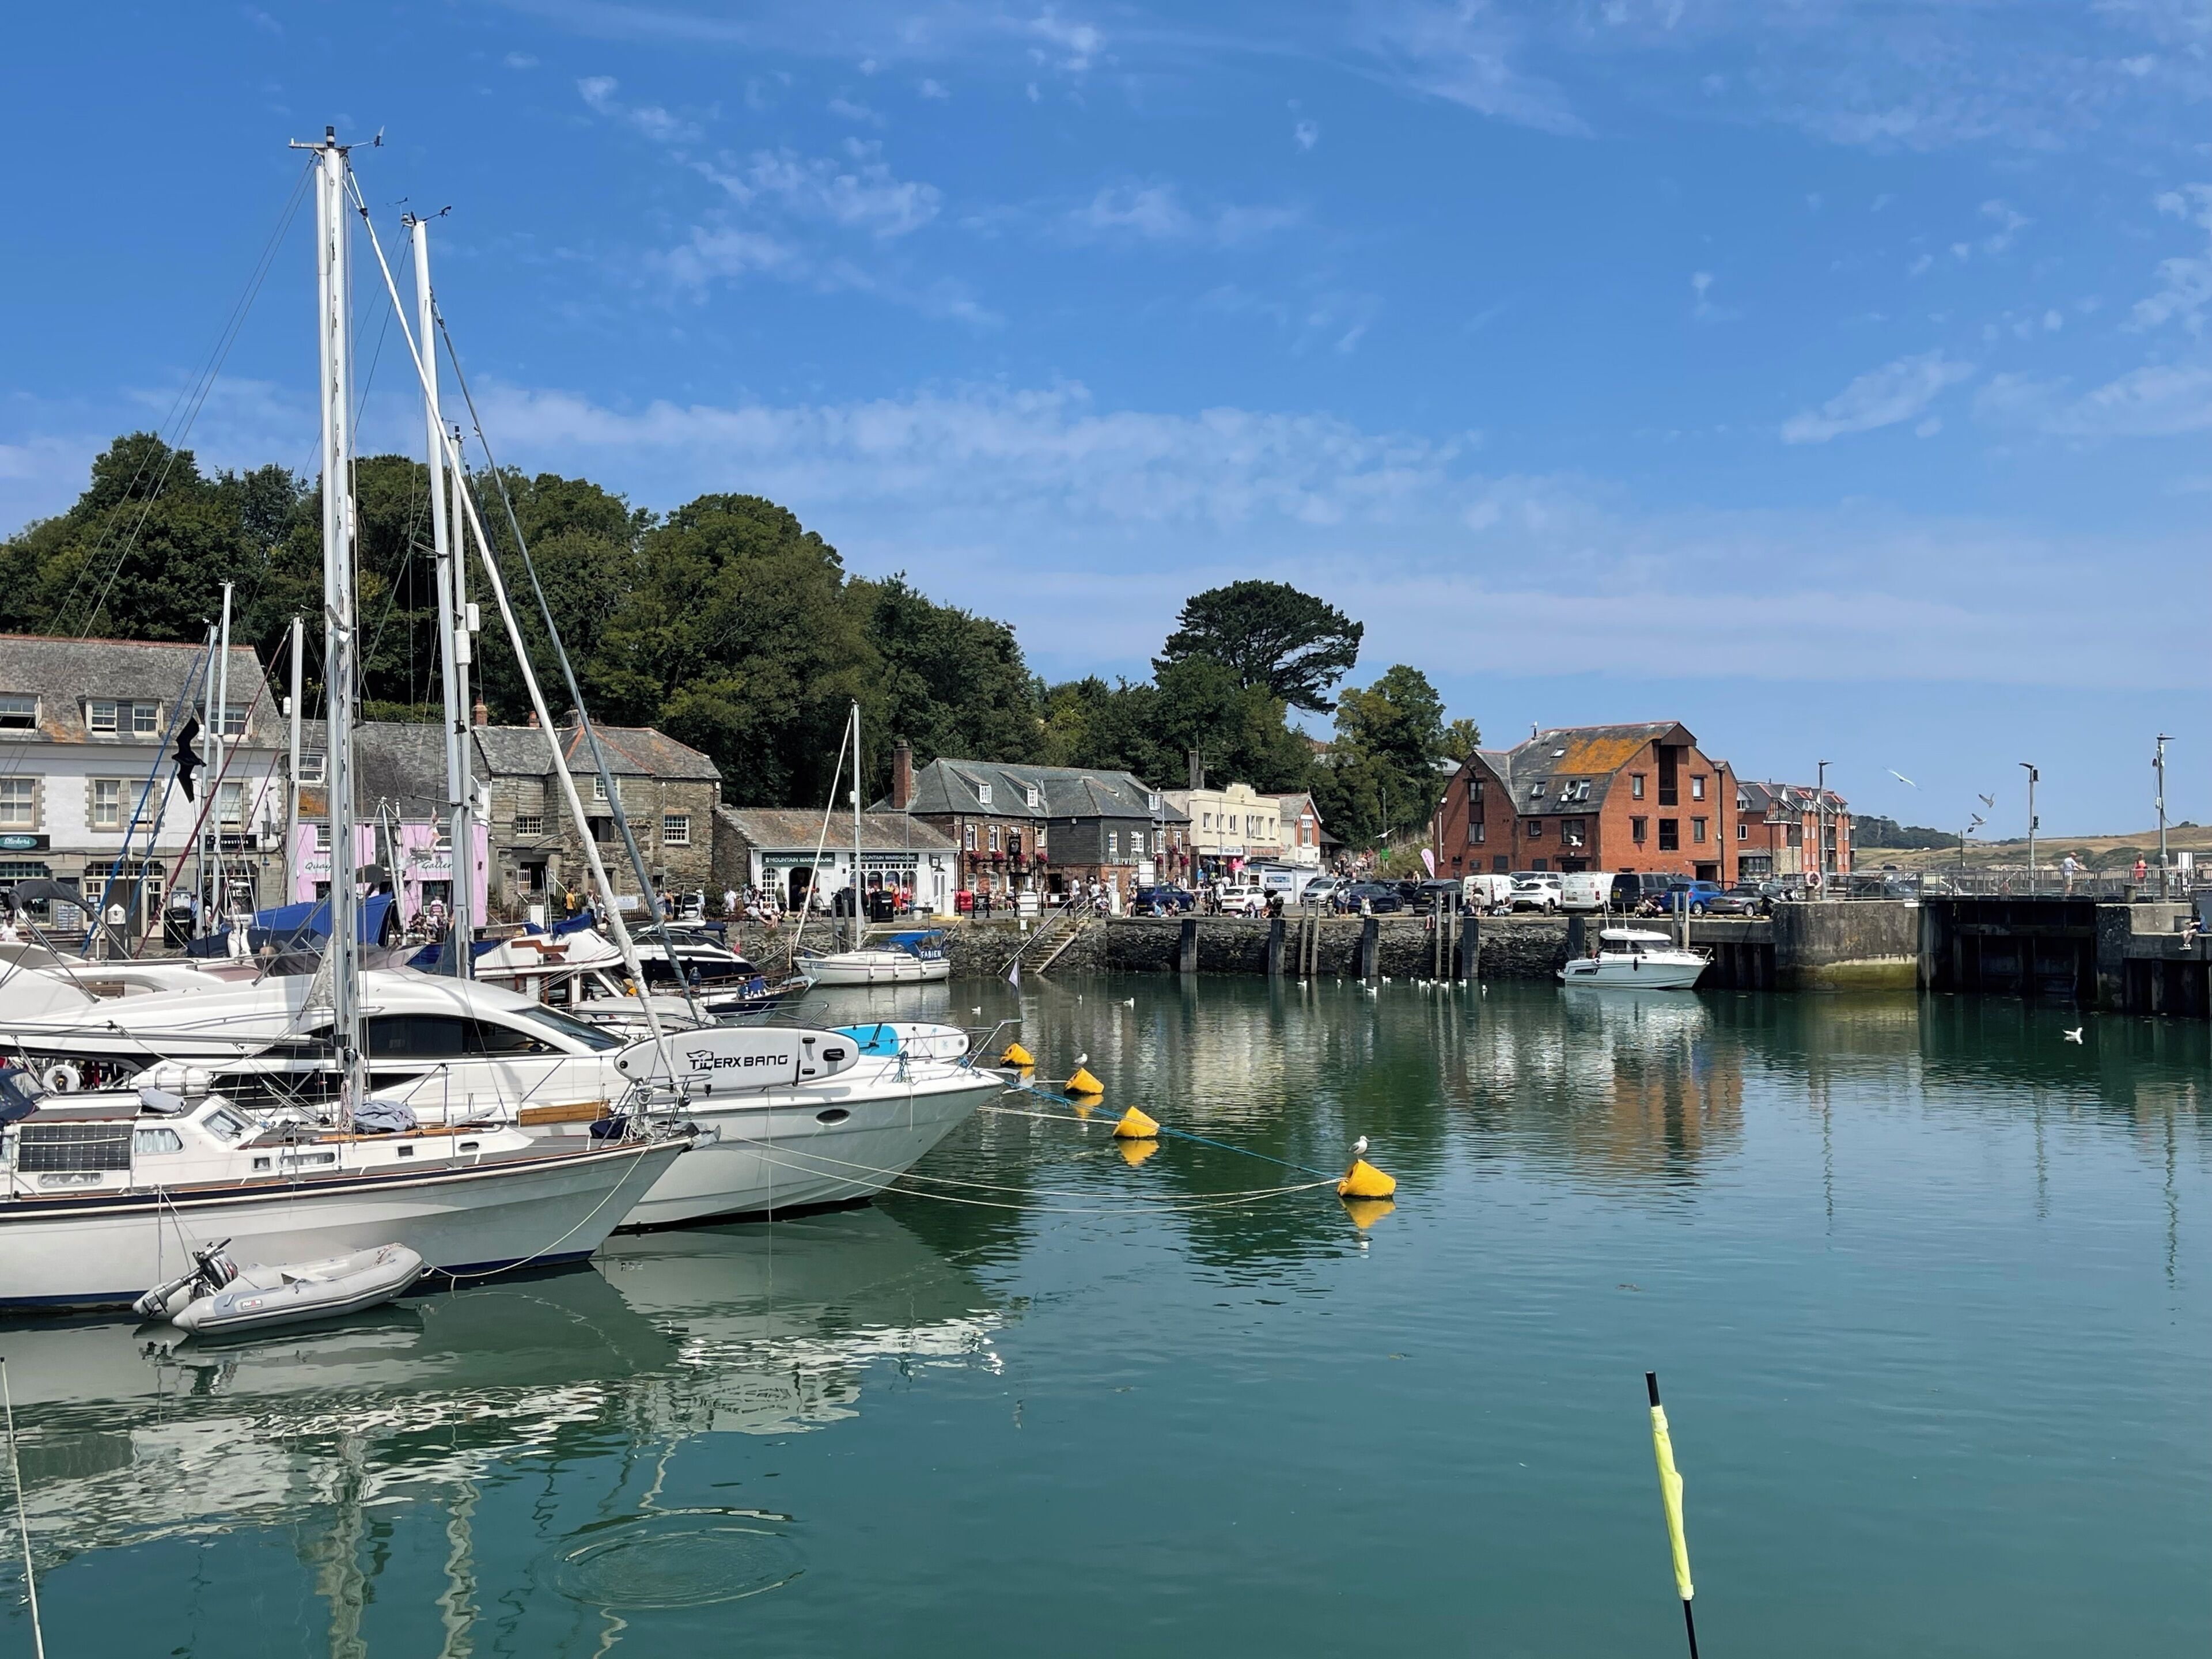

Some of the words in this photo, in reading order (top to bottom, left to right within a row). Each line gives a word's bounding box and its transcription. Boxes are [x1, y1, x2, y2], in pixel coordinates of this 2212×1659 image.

[421, 860, 453, 869] Galler
[1112, 857, 1147, 866] SHIPWRIGTS
[921, 950, 941, 959] FABIEN
[744, 1055, 788, 1067] BANG
